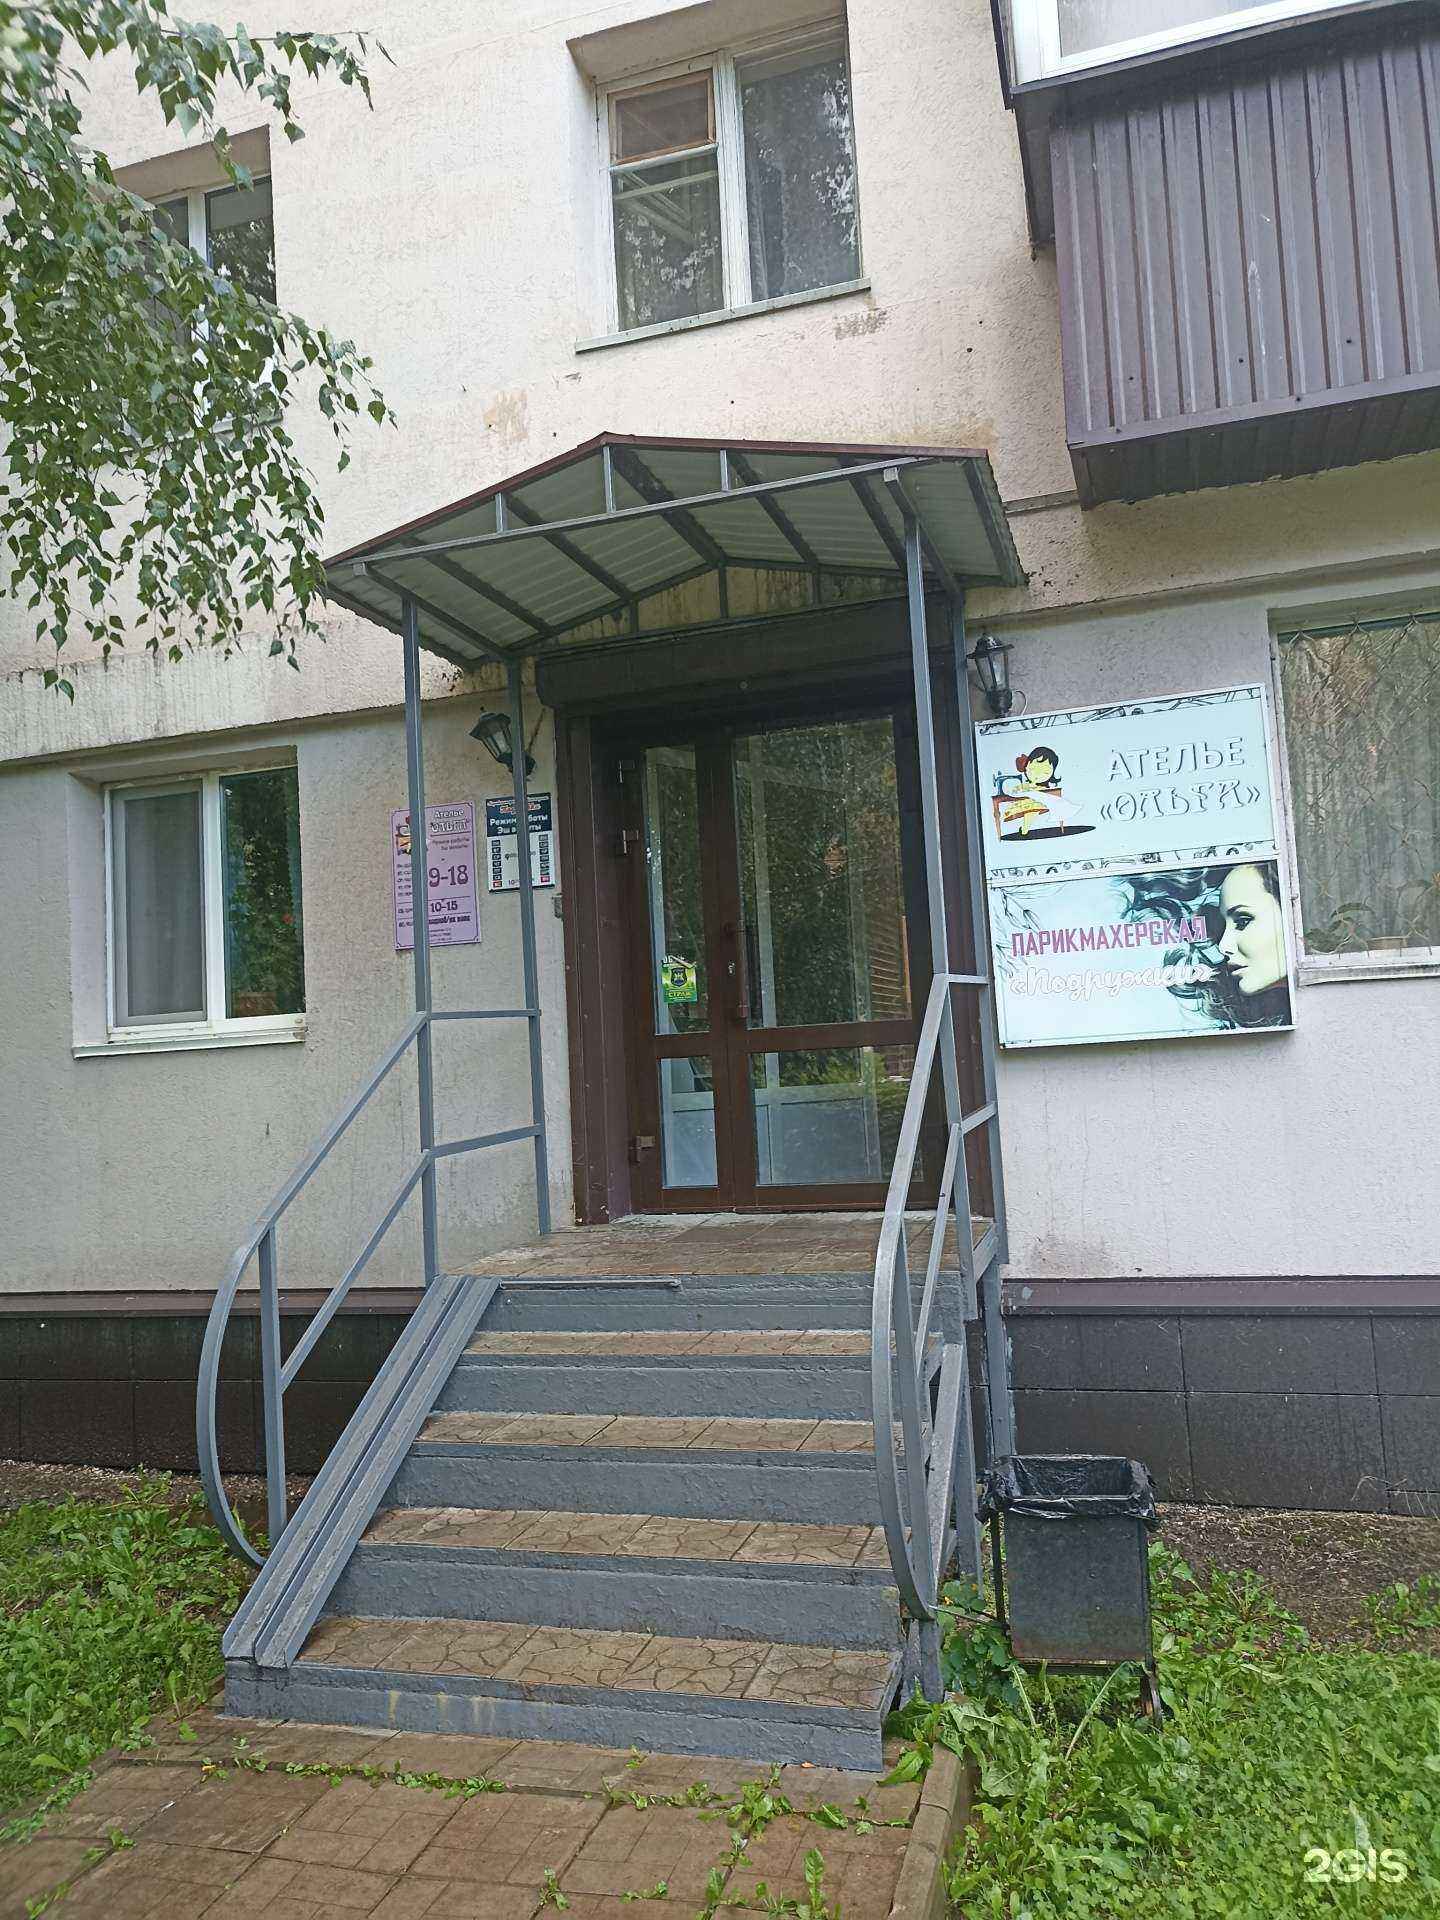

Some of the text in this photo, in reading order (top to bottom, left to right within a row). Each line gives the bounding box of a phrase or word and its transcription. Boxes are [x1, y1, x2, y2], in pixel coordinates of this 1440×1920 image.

[1107, 736, 1246, 784] АТЕЛЬЕ
[434, 809, 464, 819] Ателье
[429, 864, 468, 888] 9-18
[431, 900, 458, 913] 10-15
[1011, 915, 1208, 957] ПАРИКМАХЕРСКАЯ
